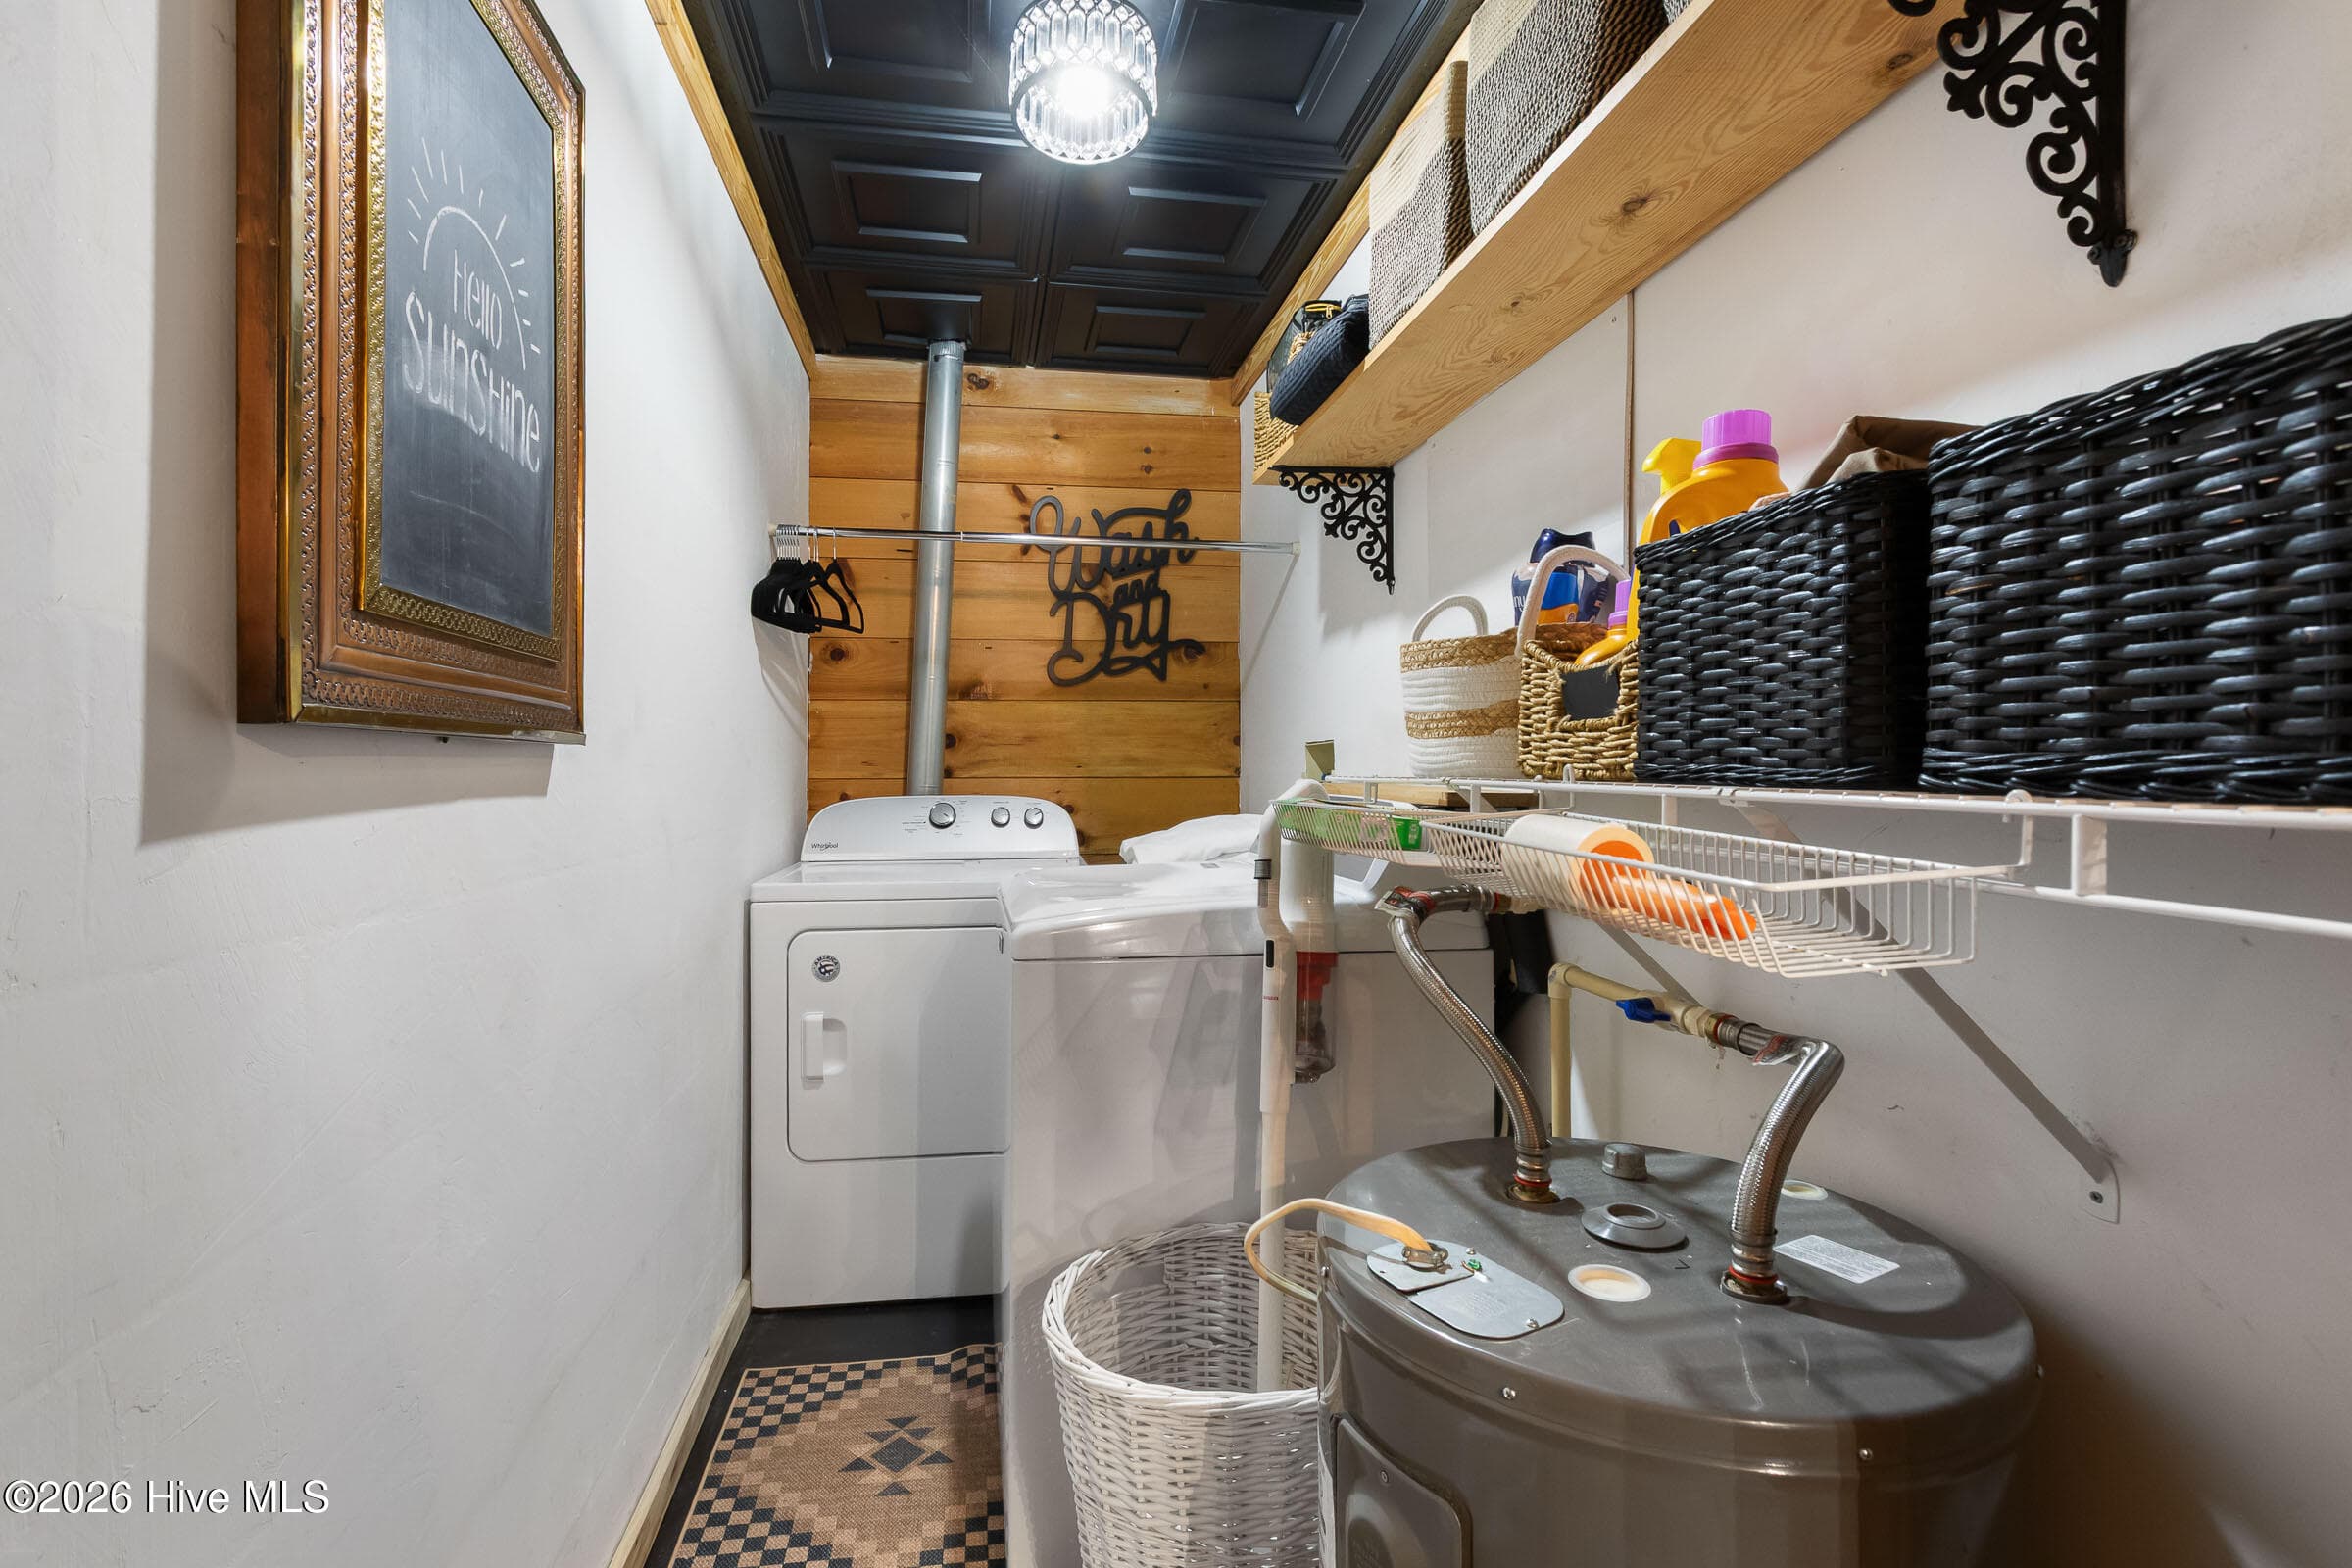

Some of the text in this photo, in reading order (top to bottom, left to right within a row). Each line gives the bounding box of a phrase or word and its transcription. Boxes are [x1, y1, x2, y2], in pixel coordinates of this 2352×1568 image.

[454, 249, 502, 350] Hello
[1030, 488, 1200, 596] Wash
[1047, 590, 1206, 687] Dry
